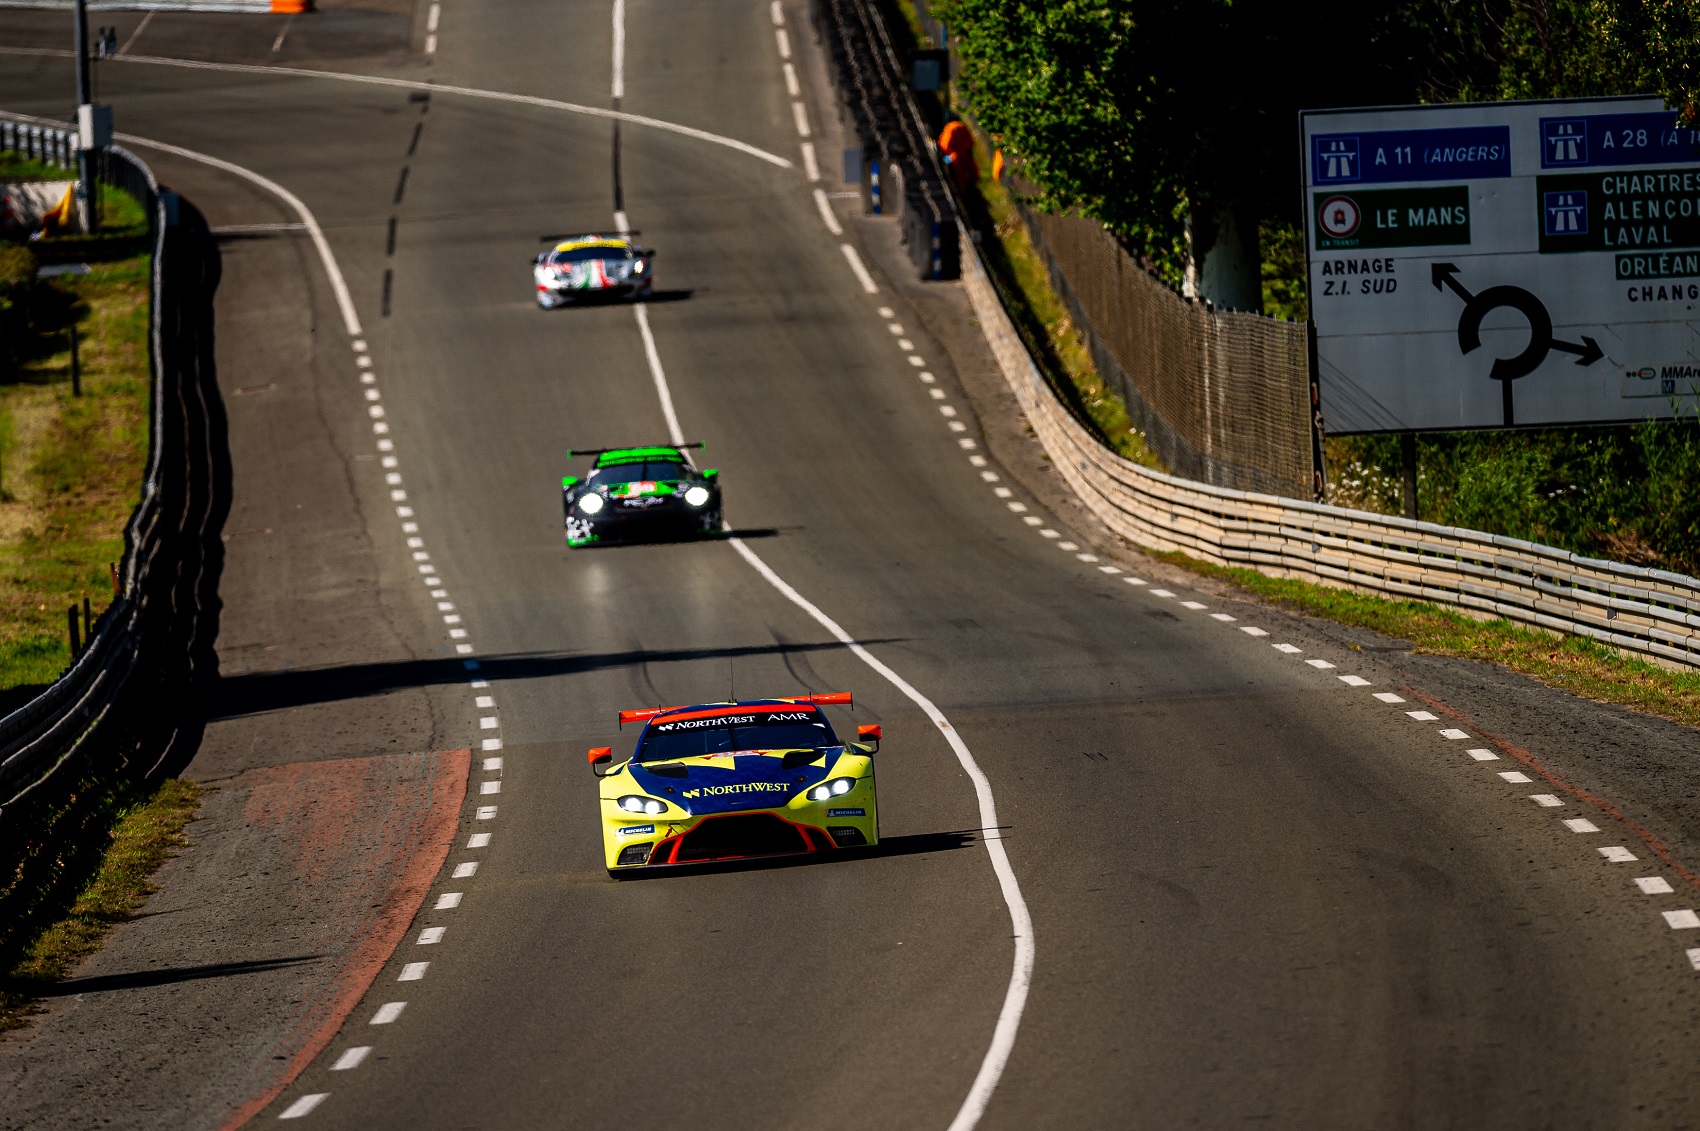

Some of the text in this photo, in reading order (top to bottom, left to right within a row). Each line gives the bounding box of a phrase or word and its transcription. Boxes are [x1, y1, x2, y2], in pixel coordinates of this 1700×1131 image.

[1603, 130, 1615, 149] A
[1622, 129, 1648, 148] 28
[1660, 129, 1679, 149] (A
[1375, 143, 1506, 166] A 11 (ANGERS)
[1377, 206, 1466, 229] LE MANS
[1604, 224, 1673, 246] LAVAL
[1323, 258, 1395, 276] ARNAGE
[1323, 278, 1398, 295] Z.I. SUD
[1628, 284, 1699, 302] CHANG
[768, 713, 810, 721] AMR
[703, 782, 790, 797] NORTHWEST
